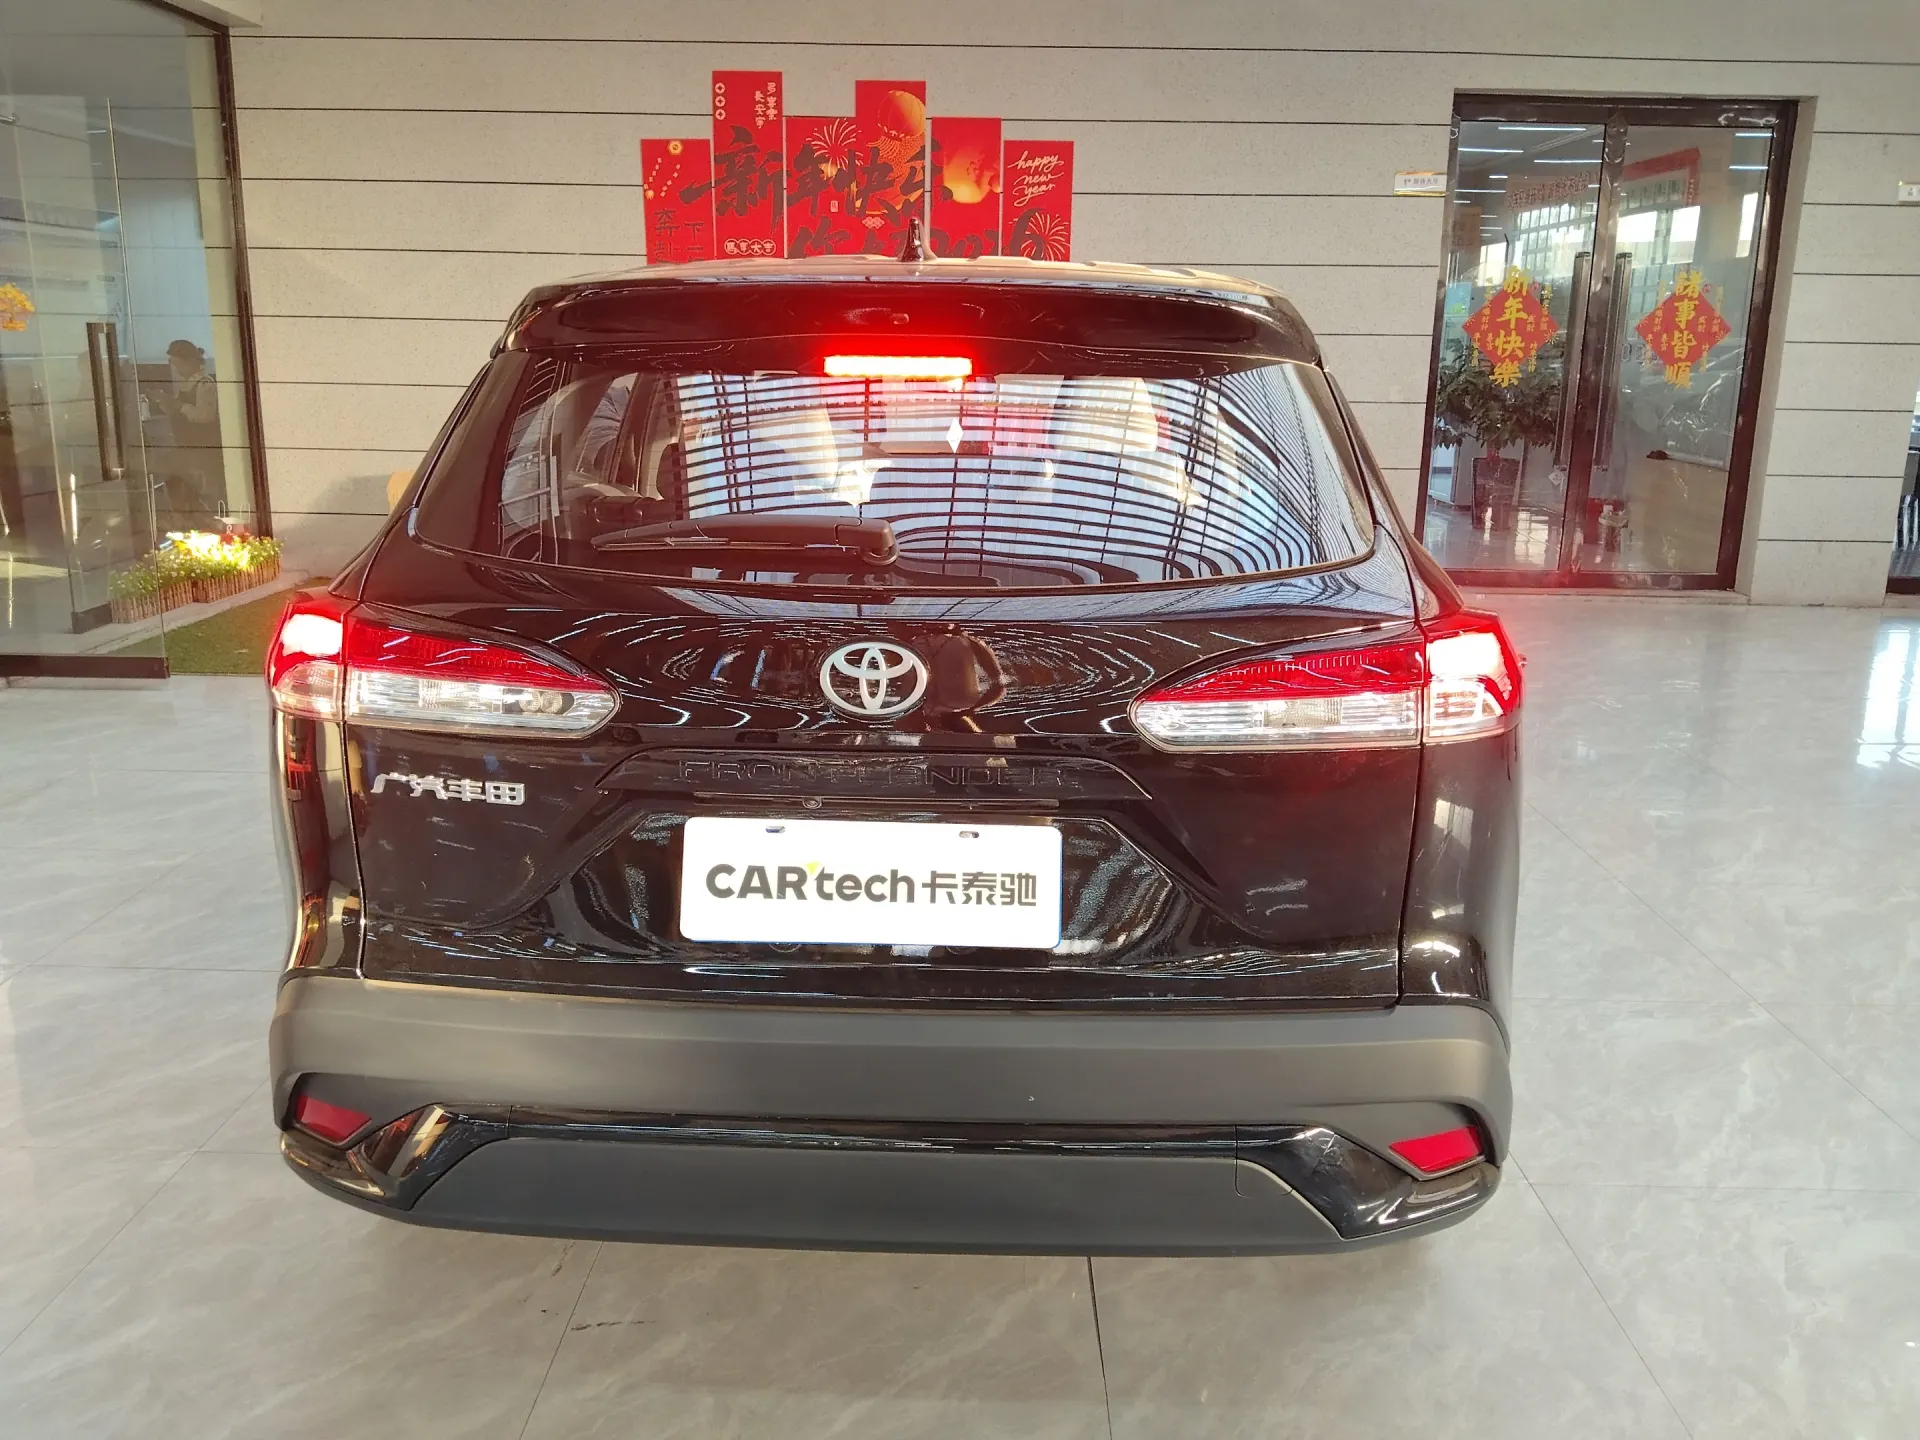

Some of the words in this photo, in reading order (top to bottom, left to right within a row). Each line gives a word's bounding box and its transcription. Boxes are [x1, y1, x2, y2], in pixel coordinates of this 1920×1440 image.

[1008, 150, 1064, 174] happy
[679, 125, 954, 235] 新年快乐
[1013, 172, 1064, 186] new
[1012, 183, 1056, 207] year
[371, 771, 525, 806] 广汽丰田
[922, 869, 1037, 907] 卡泰驰
